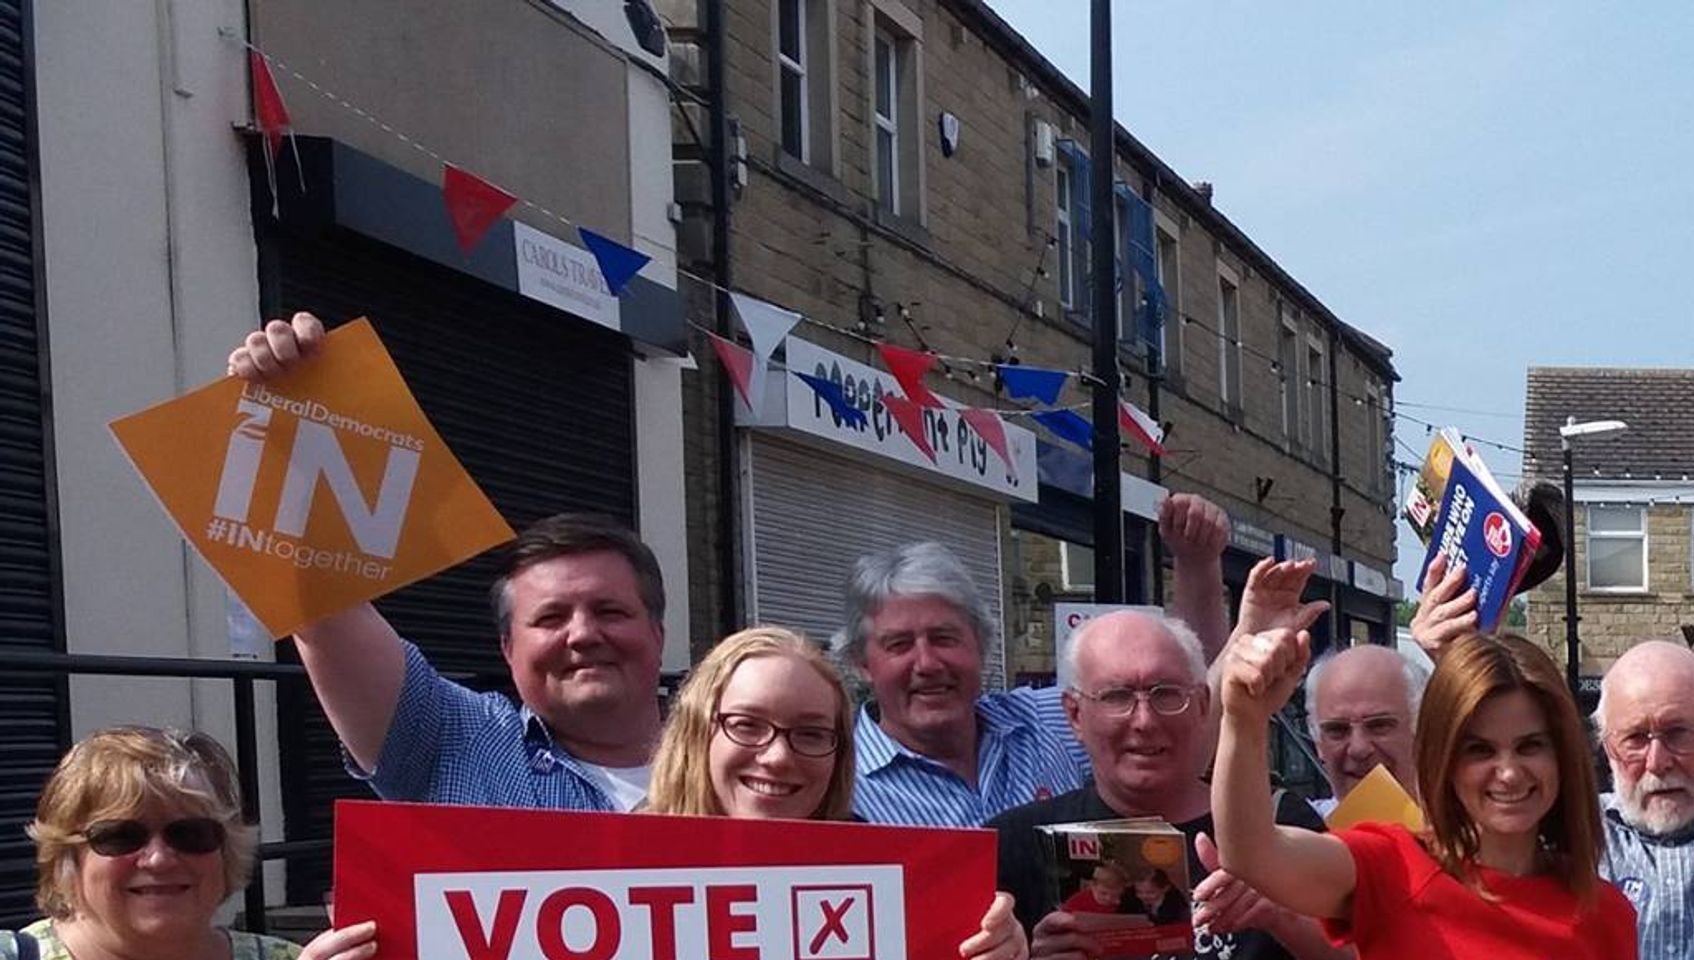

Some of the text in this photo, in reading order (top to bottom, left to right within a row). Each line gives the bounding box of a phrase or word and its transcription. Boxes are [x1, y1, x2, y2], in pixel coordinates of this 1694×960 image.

[1447, 484, 1467, 529] WHO
[207, 518, 392, 581] #INtogether
[1070, 839, 1099, 856] IN
